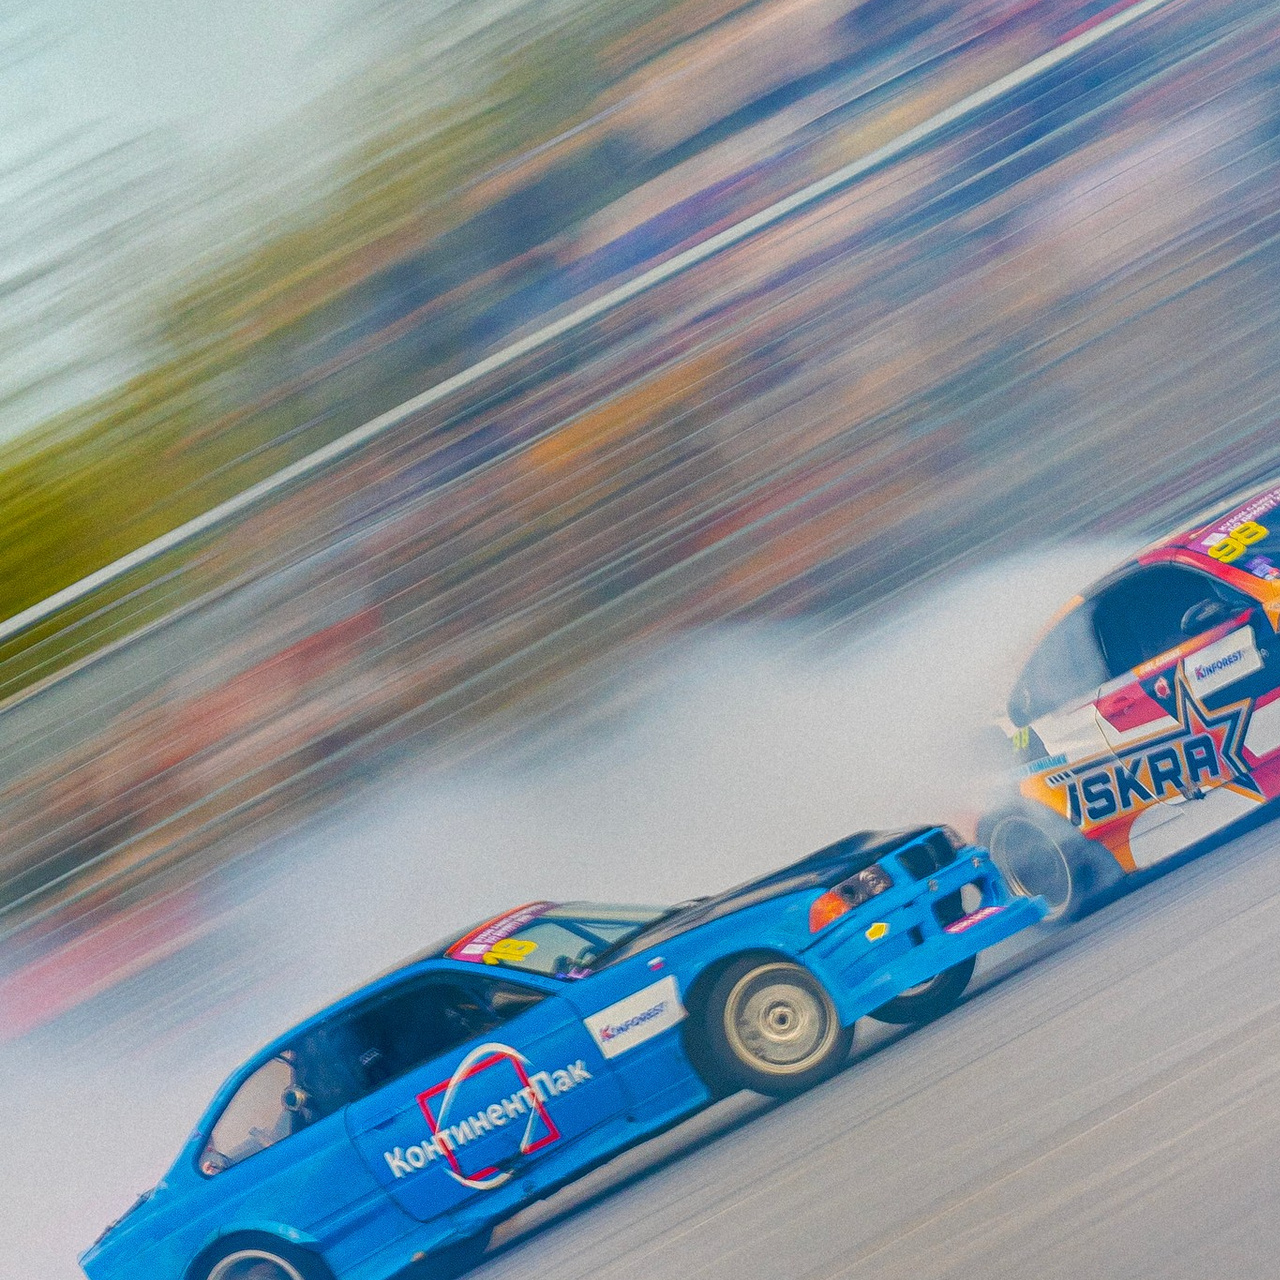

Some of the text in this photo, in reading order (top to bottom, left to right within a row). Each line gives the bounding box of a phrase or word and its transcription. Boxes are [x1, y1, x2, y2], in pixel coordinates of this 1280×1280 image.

[1208, 521, 1270, 563] 98
[1195, 649, 1244, 680] KINFOREST
[1067, 733, 1220, 826] ISKRA
[483, 938, 537, 965] 18
[384, 1059, 593, 1178] КонтинентПак
